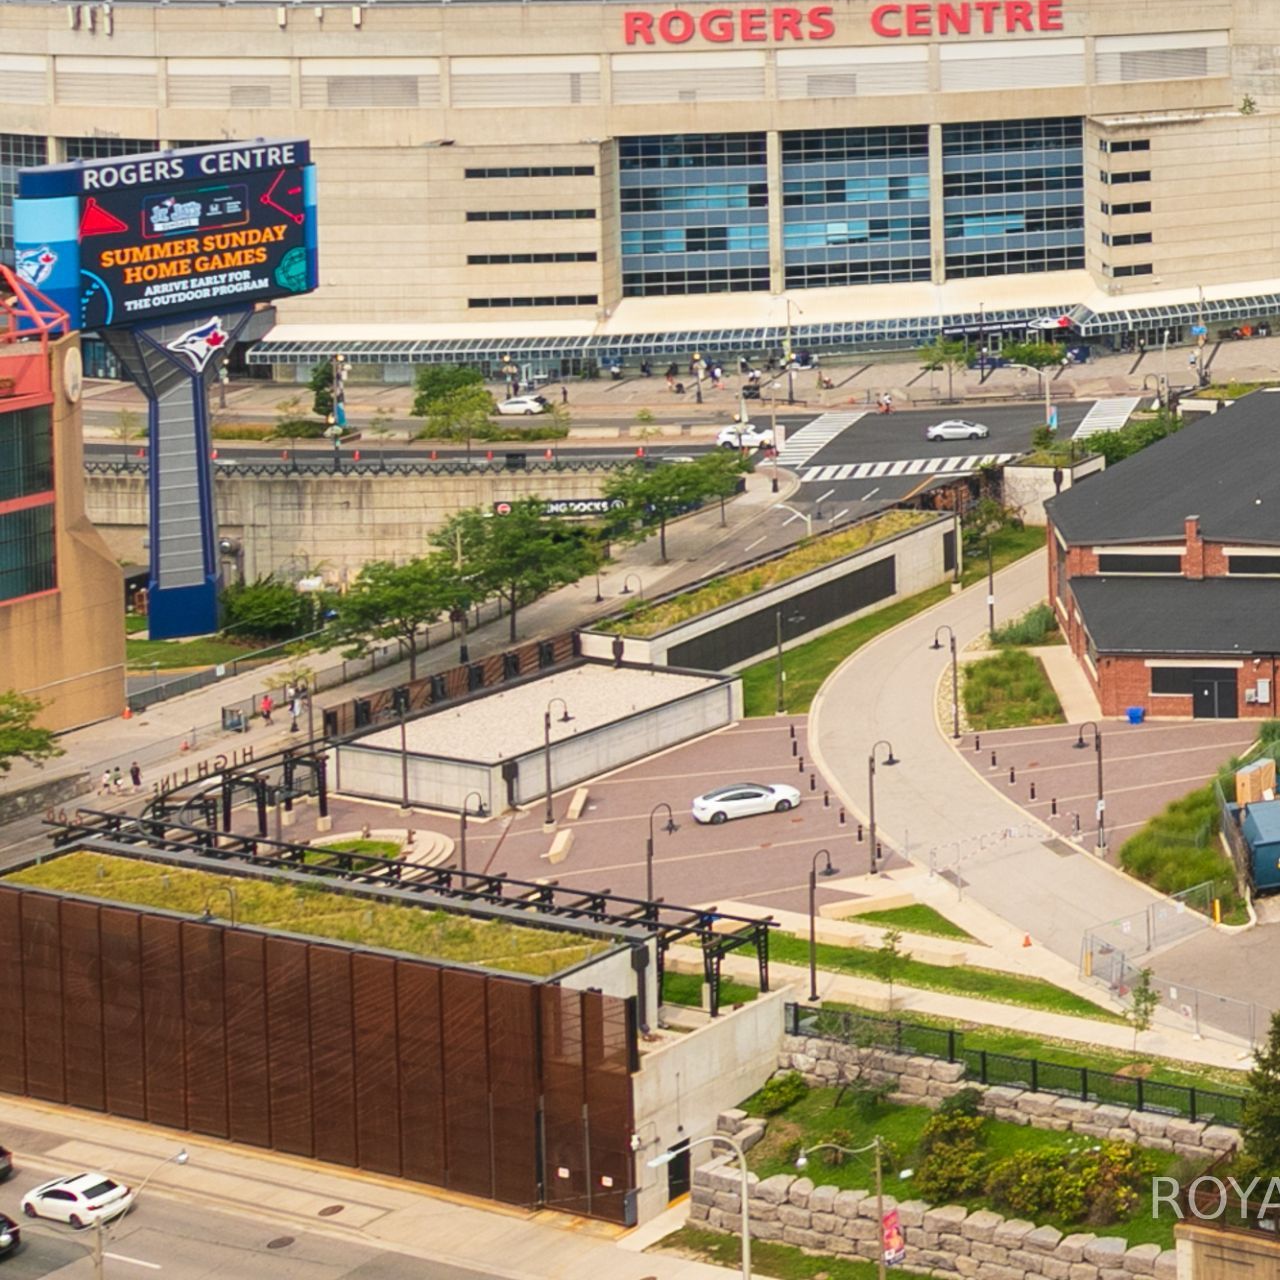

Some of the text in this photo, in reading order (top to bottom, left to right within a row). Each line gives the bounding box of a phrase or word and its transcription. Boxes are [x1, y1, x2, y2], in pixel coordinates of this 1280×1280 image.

[624, 0, 1064, 45] ROGERS CENTRE
[83, 145, 295, 190] ROGERS CENTRE
[100, 225, 287, 267] SUMMER SUNDAY
[123, 247, 267, 284] HOME GAMES
[124, 278, 269, 311] THE OUTDOOR PROGRAM
[144, 270, 251, 296] ARRIVE EARLY FOR
